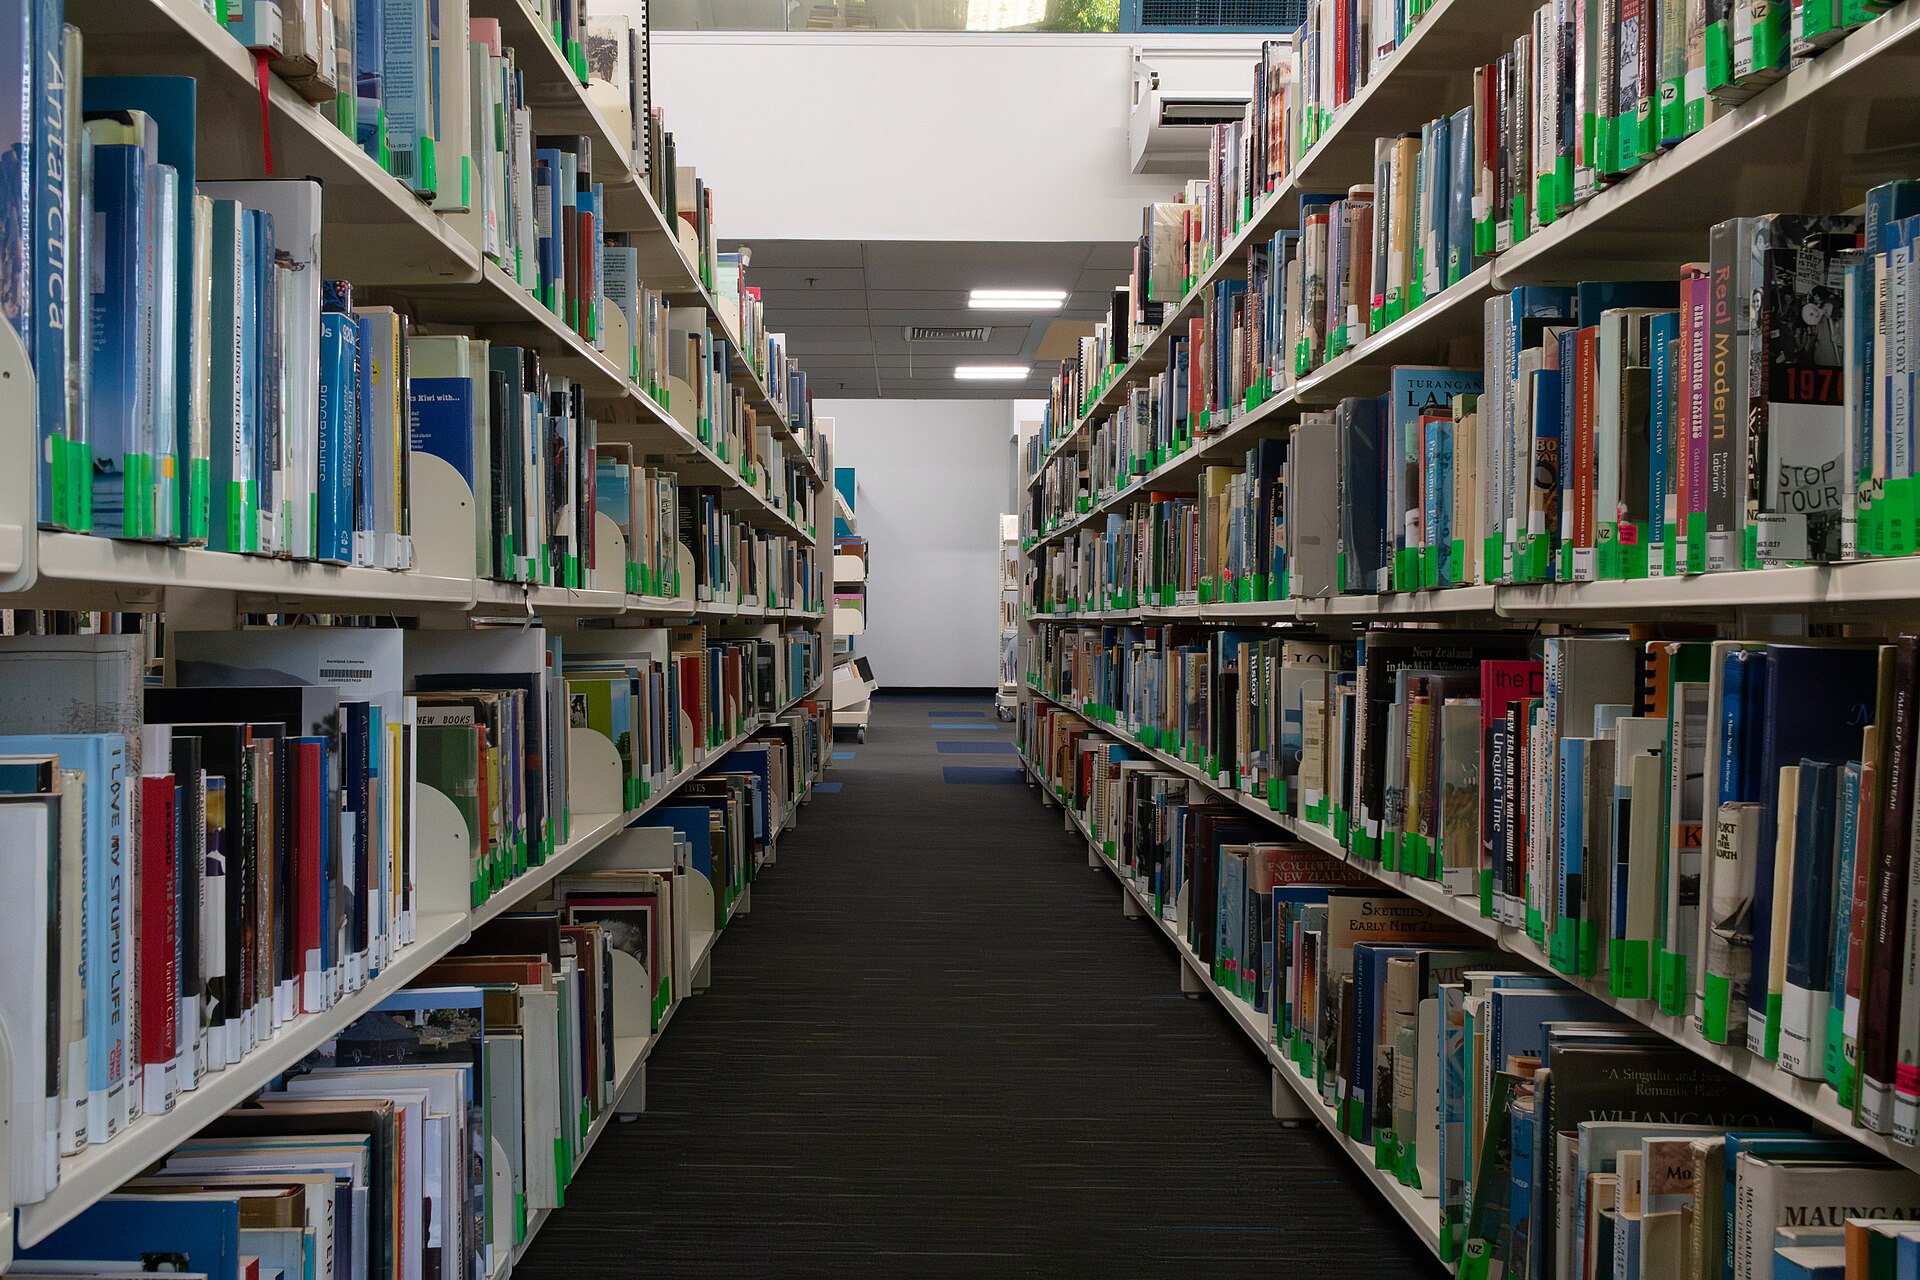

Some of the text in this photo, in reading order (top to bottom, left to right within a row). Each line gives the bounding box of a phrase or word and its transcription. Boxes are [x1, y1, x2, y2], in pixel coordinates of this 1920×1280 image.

[1750, 5, 1767, 19] NZ
[1542, 16, 1550, 53] Knocking
[1542, 83, 1549, 91] in
[1542, 114, 1550, 146] Zealand
[46, 50, 66, 330] Antarctica
[1868, 202, 1879, 250] SPIRIT
[1714, 264, 1732, 325] Real
[1694, 304, 1704, 329] THE
[1693, 330, 1703, 392] SWINGING
[1896, 252, 1906, 469] NEW TERRITORY COLIN JAMES
[417, 393, 460, 402] Kiwi with...
[1407, 379, 1482, 390] TURANGAN
[1712, 333, 1730, 440] Modern
[1656, 400, 1663, 419] WE
[1692, 393, 1702, 440] SIXTIES
[1535, 439, 1558, 452] BO
[1427, 440, 1436, 500] Pre-Tasman
[1712, 452, 1722, 493] Labrum
[1720, 452, 1729, 499] Bronwyn
[1780, 460, 1836, 488] STOP
[1780, 486, 1840, 513] TOUR
[1598, 529, 1610, 539] NZ
[1386, 660, 1410, 671] in the
[1412, 646, 1473, 658] New Zealand
[1249, 654, 1258, 706] history
[1496, 669, 1523, 688] the
[417, 714, 471, 725] NEW BOOKS
[110, 764, 123, 828] LOVE
[685, 783, 706, 793] LIVES
[1492, 732, 1504, 833] Unquiet Time
[1505, 709, 1514, 862] NEW ZEALAND NEW MILLENNIUM
[1558, 757, 1567, 881] RANGIHOUA Mission
[1878, 690, 1905, 944] TALES OF YESTERYEAR by Malcolm
[110, 834, 123, 867] MY
[1273, 872, 1367, 882] NEW ZEALAND
[110, 874, 123, 965] STUPID
[164, 802, 175, 1049] BEYOND THE PALE Farrell Cleary
[1349, 919, 1386, 931] EARLY
[110, 970, 123, 1026] LIFE
[107, 1049, 116, 1082] Cho
[1636, 1083, 1689, 1096] Romantic
[326, 1199, 334, 1276] AFTER
[1467, 1243, 1483, 1255] NZ
